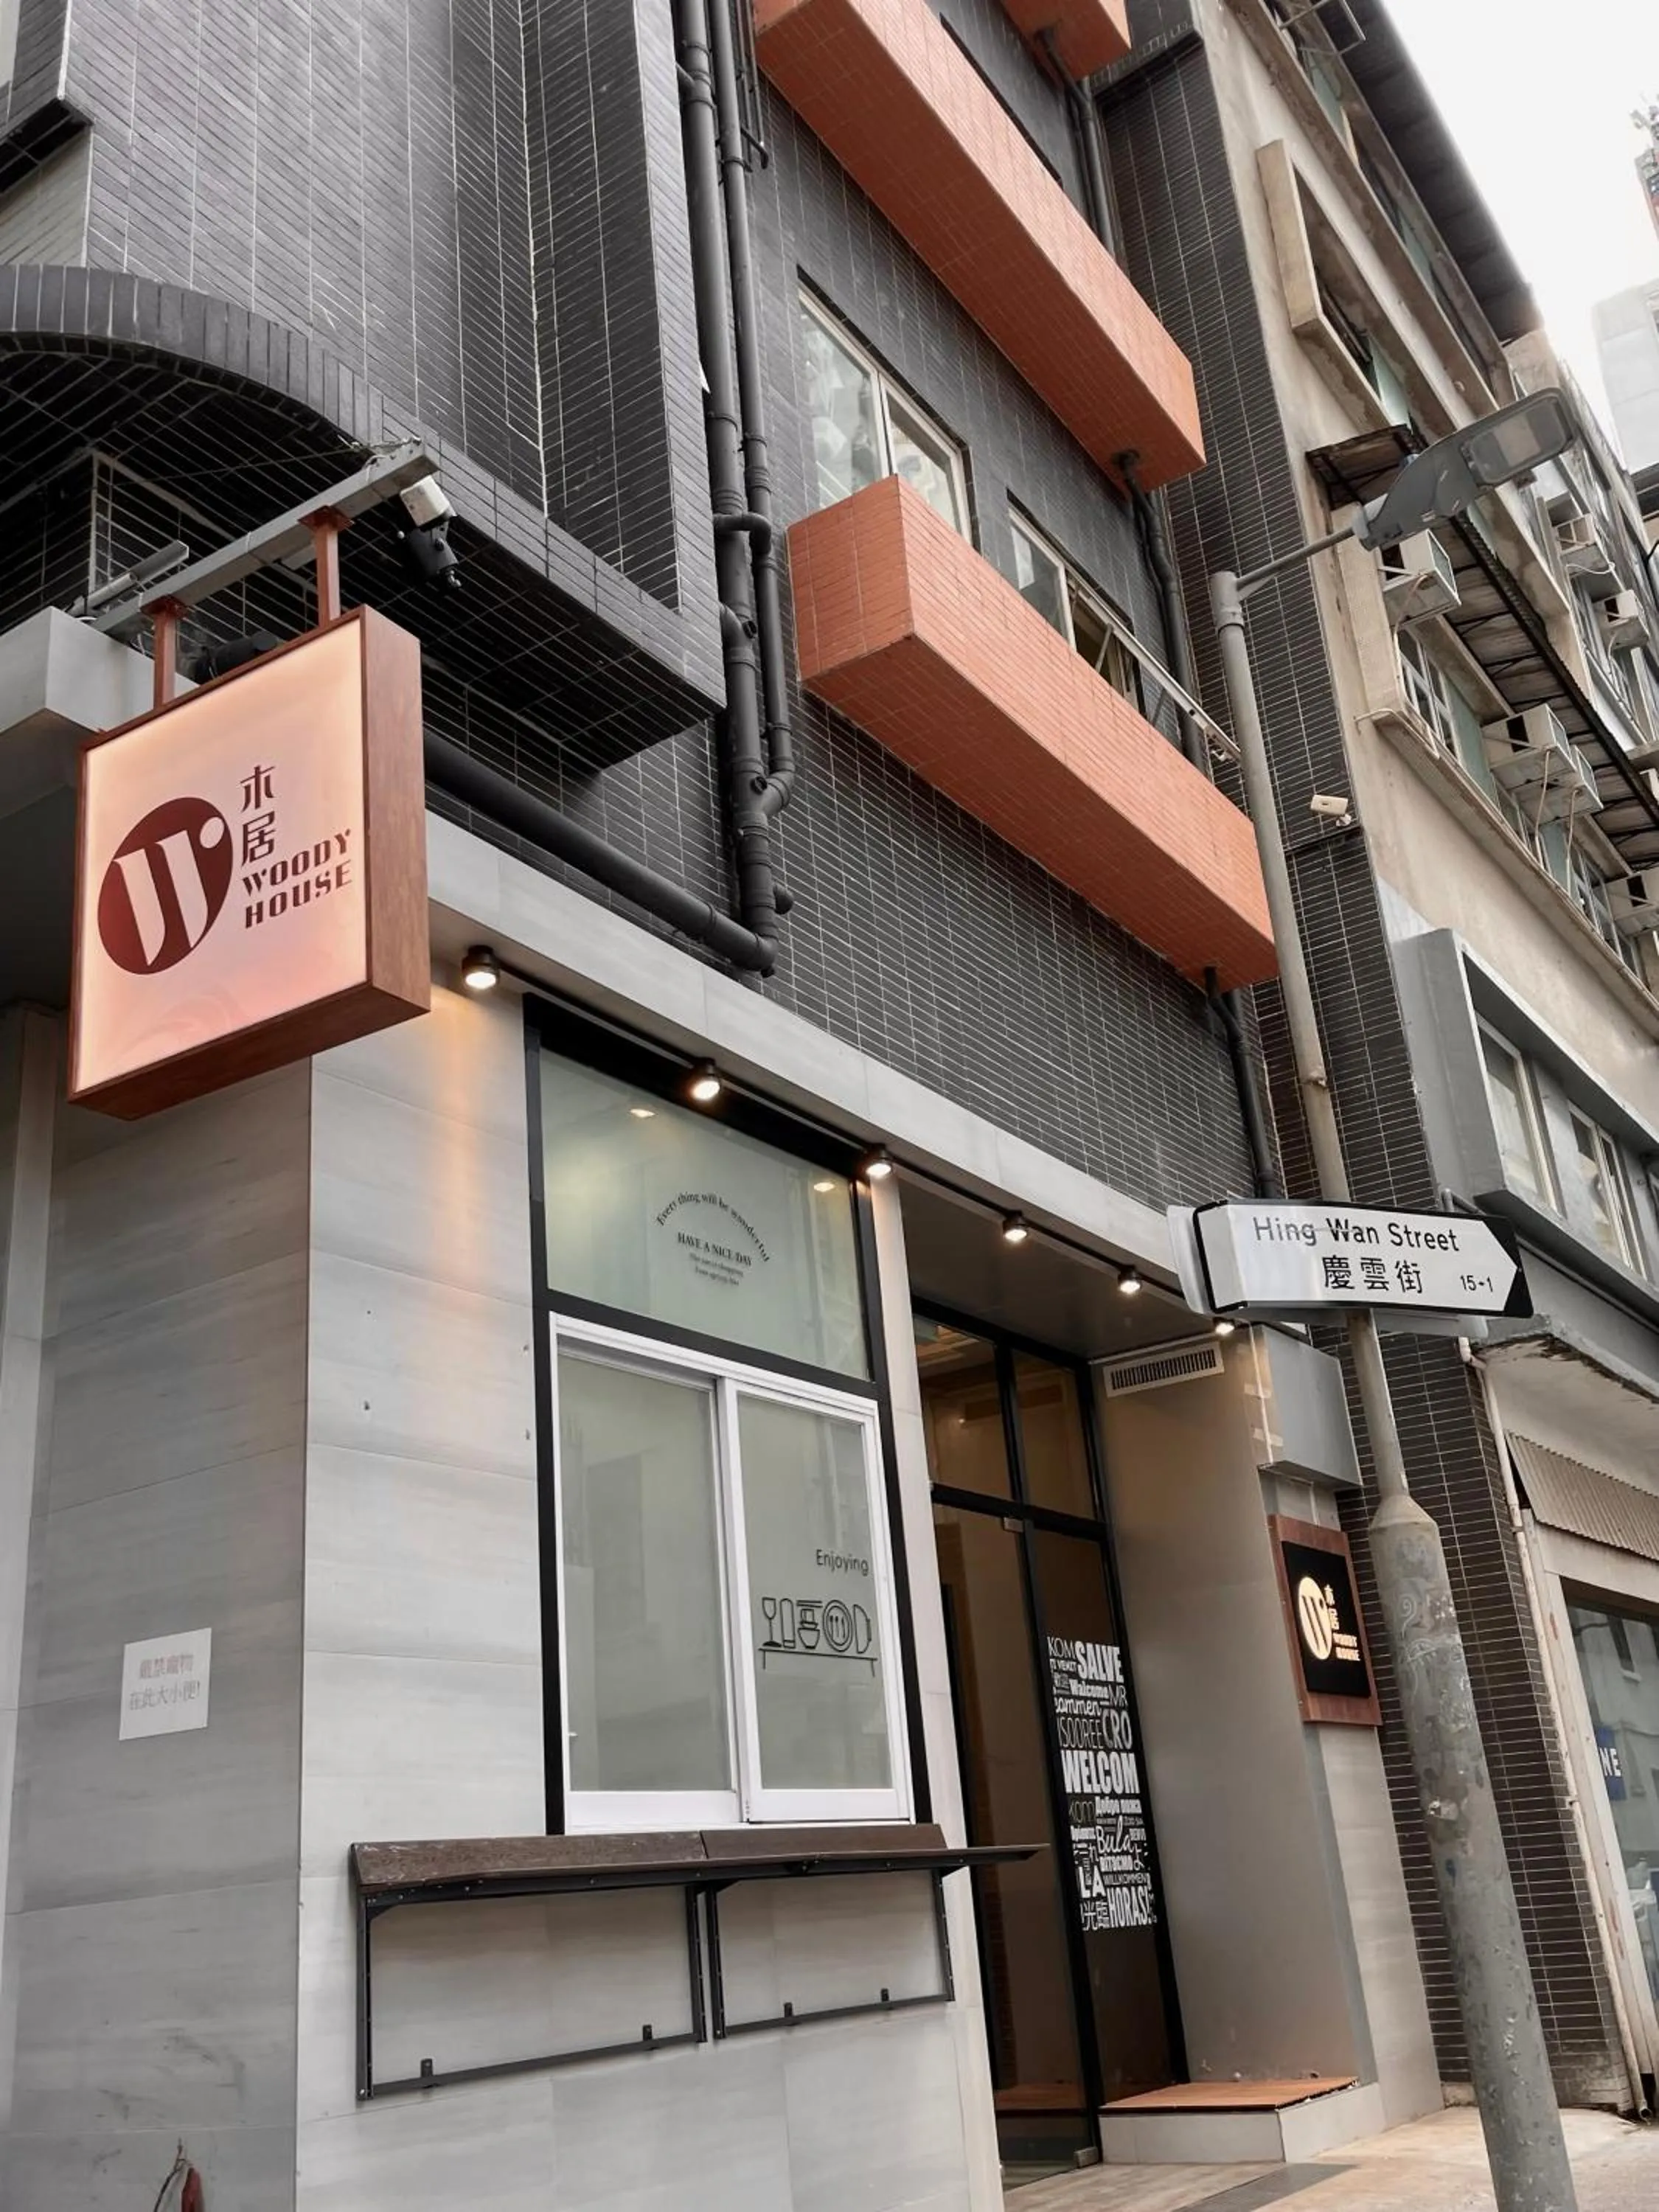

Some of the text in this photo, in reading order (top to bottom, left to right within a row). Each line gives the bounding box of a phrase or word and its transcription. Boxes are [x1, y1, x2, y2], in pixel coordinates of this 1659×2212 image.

[240, 764, 276, 867] 木居
[242, 828, 352, 898] WOODY
[244, 859, 353, 929] HOUSE
[701, 1192, 718, 1206] will
[677, 1231, 703, 1249] HAVE
[703, 1241, 711, 1253] A
[712, 1243, 732, 1260] NICE
[734, 1251, 752, 1267] DAY
[1253, 1217, 1460, 1252] Hing Wan Street
[1322, 1255, 1424, 1293] 慶雲街
[1460, 1274, 1494, 1293] 15-1
[815, 1548, 869, 1577] Enjoying
[1074, 1640, 1124, 1683] SALVE
[1102, 1708, 1133, 1750] CRO
[1061, 1749, 1141, 1794] WELCOM
[1095, 1815, 1134, 1854] Bula
[1078, 1865, 1106, 1899] LA
